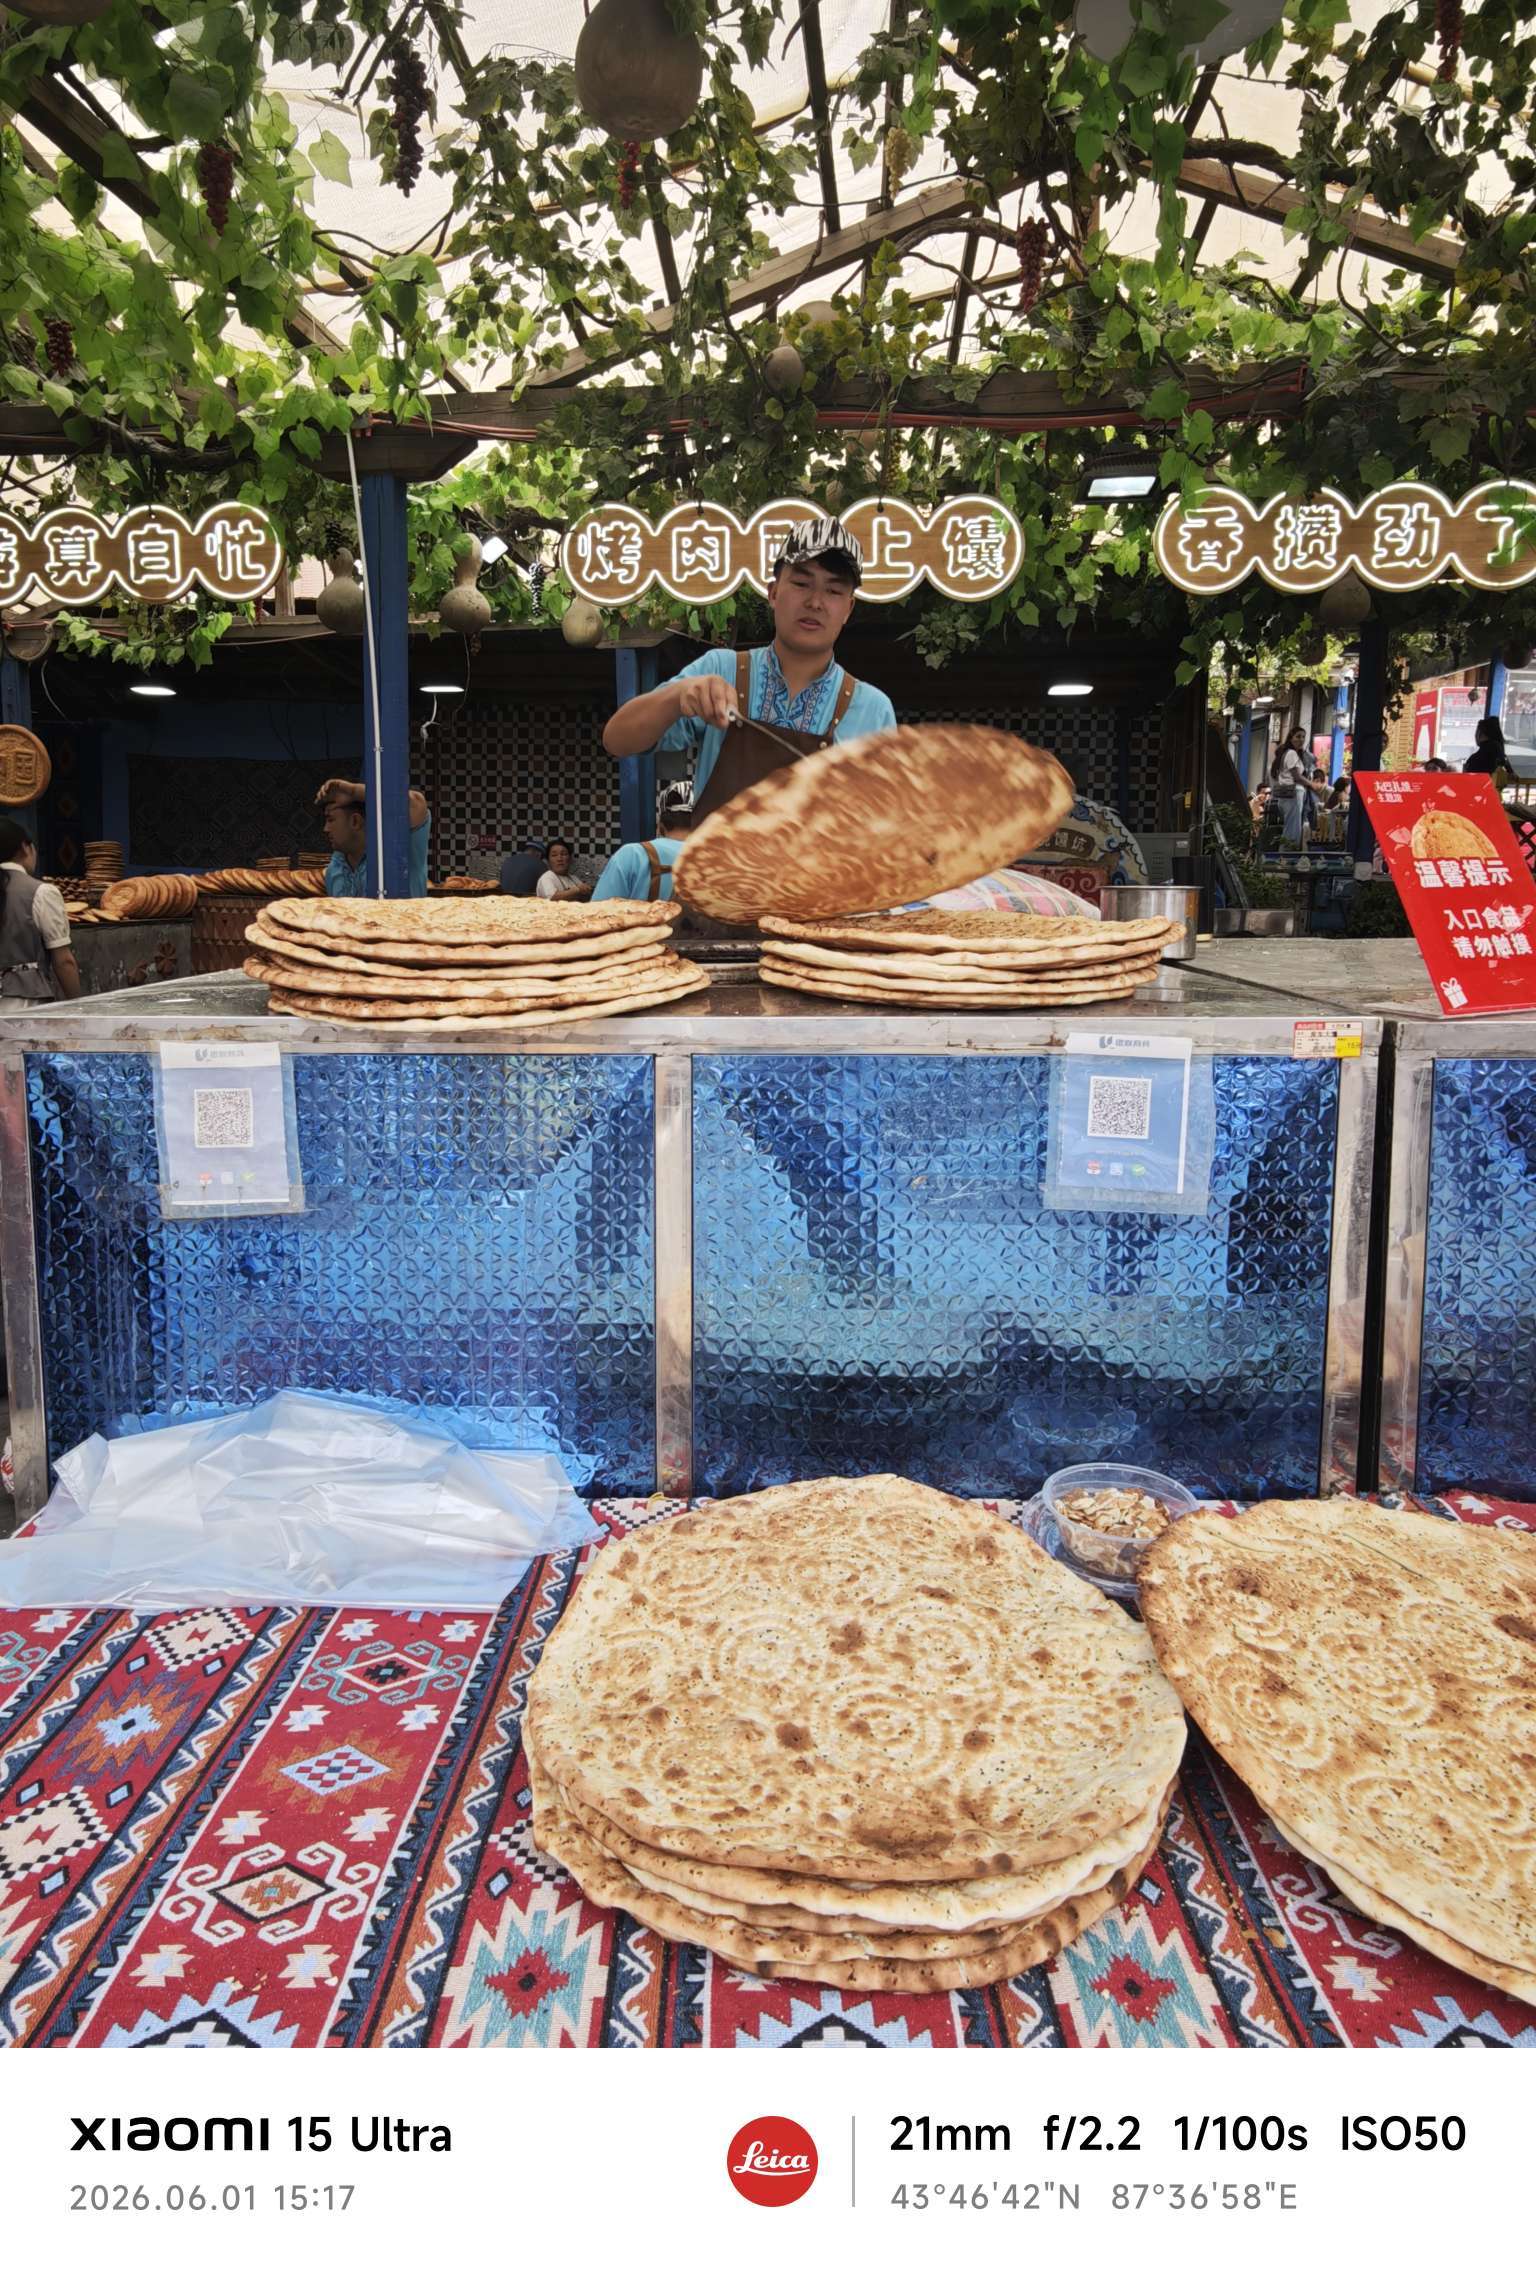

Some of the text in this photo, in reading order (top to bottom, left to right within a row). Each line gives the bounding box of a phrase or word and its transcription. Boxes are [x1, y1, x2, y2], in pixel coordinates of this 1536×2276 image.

[1414, 858, 1513, 888] 温馨提示
[1443, 904, 1522, 930] 入口食品
[1451, 933, 1533, 959] 请勿触摸
